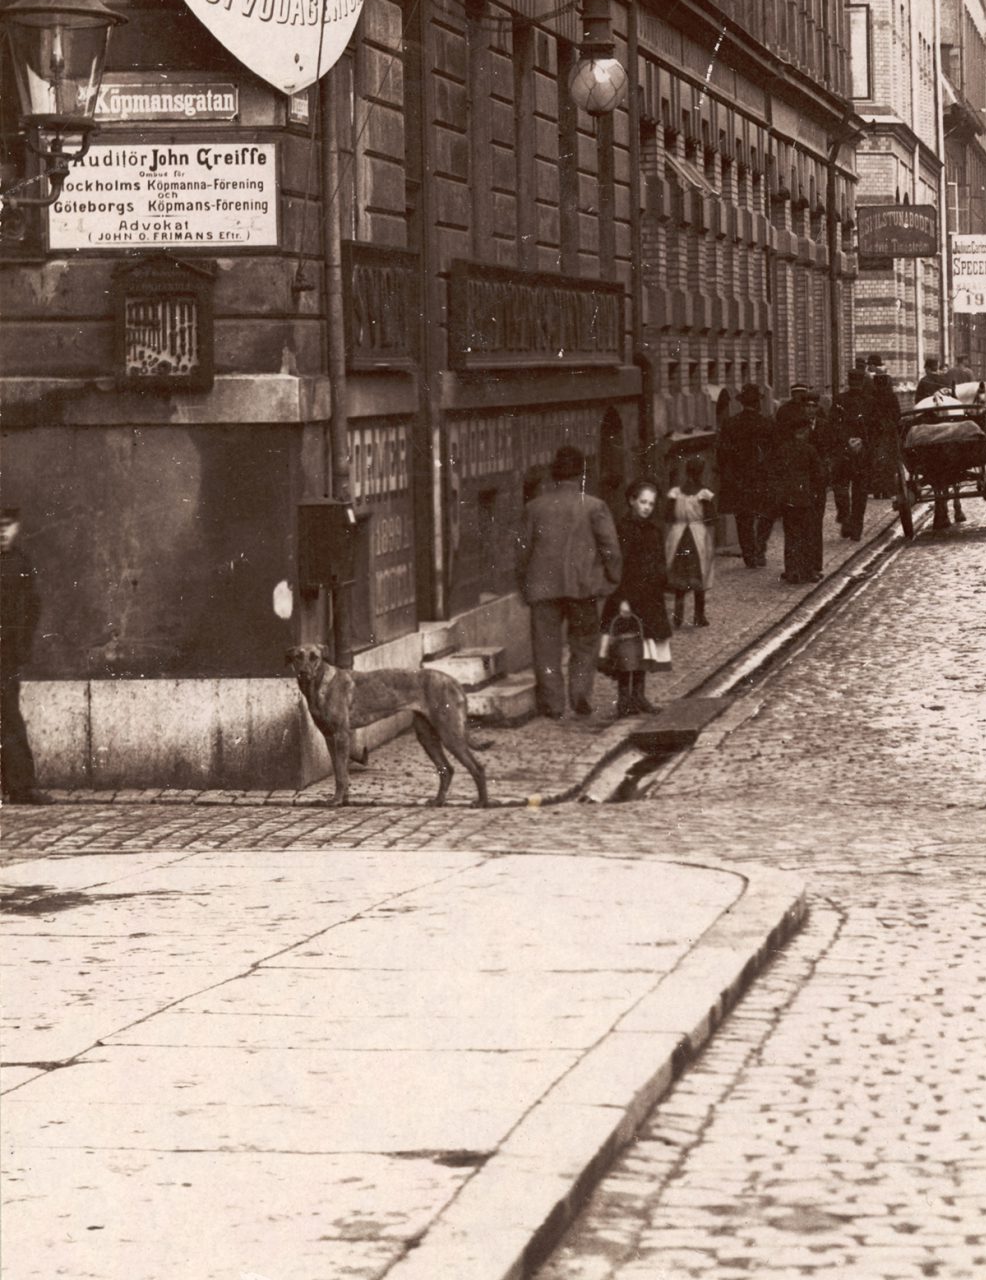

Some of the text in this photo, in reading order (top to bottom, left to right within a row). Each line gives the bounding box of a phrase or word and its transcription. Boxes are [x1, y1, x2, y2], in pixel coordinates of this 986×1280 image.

[95, 89, 235, 116] Köpmansgatan
[151, 148, 189, 171] John
[196, 147, 268, 170] Greiffe
[60, 178, 264, 193] ockholms Köpmanna-Förening
[157, 191, 178, 199] och
[53, 199, 269, 215] Göteborgs Köpmans-Förening
[118, 220, 189, 231] Advokat
[98, 232, 133, 241] JOHN
[153, 231, 213, 240] FRIMANS
